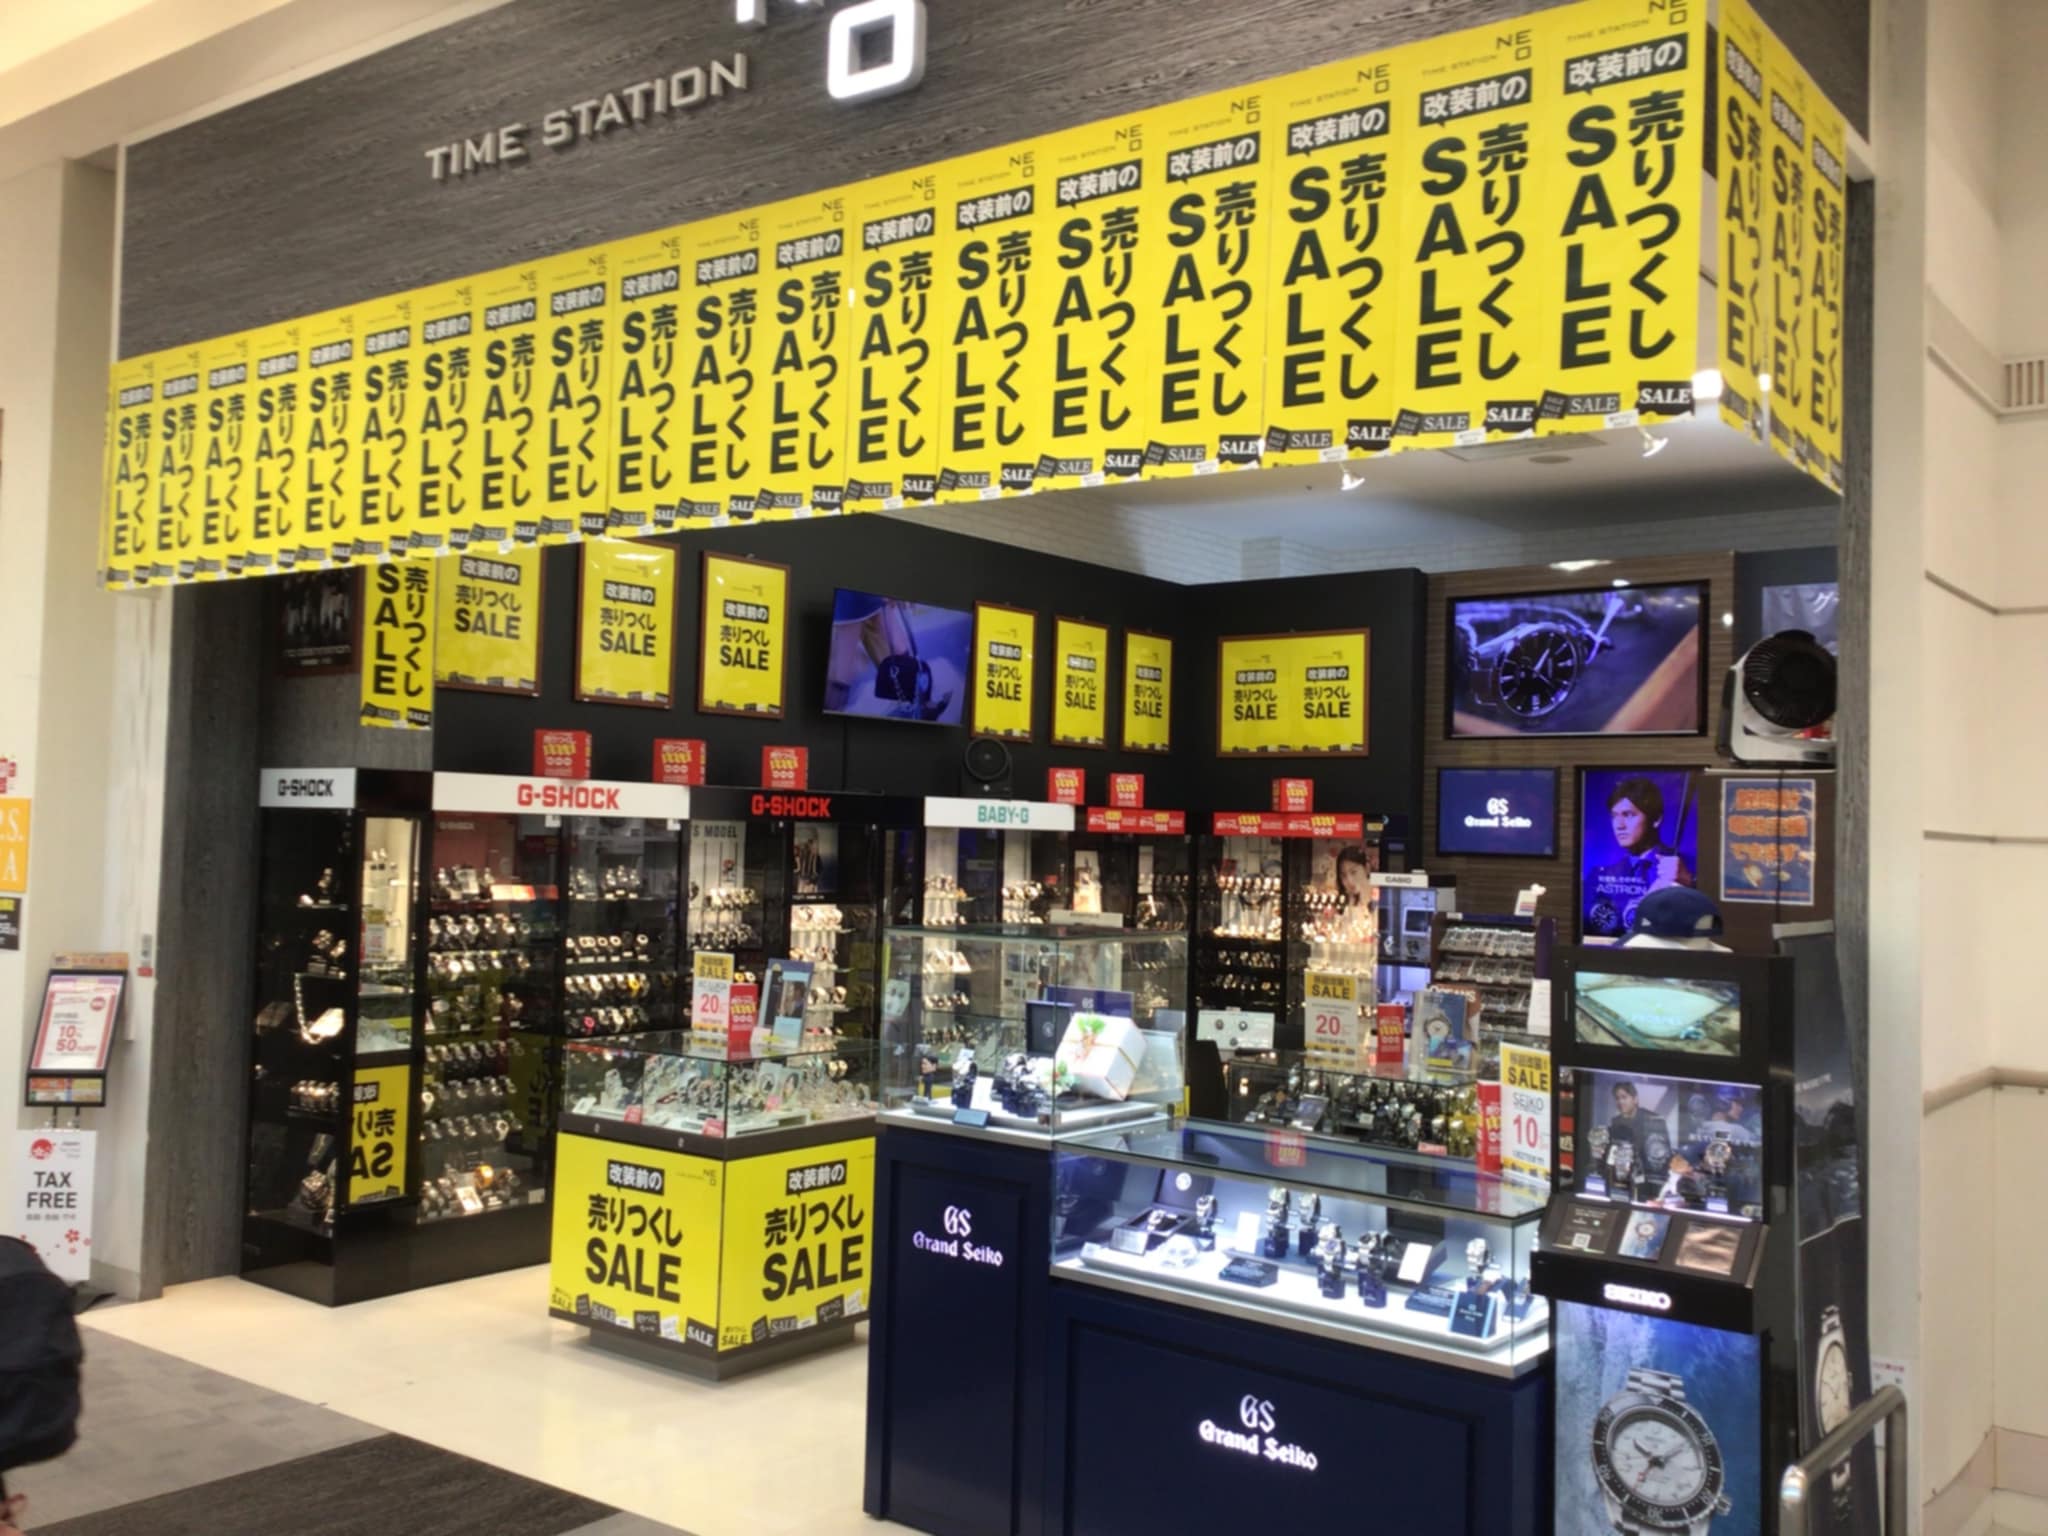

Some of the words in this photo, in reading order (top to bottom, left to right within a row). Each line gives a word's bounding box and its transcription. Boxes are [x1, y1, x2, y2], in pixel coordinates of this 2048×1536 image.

[1568, 39, 1684, 88] 改装前の
[425, 123, 526, 179] TIME
[542, 52, 747, 146] STATION
[1423, 74, 1528, 120] 改装前の
[1291, 107, 1387, 150] 改装前の
[1170, 137, 1257, 177] 改装前の
[1060, 164, 1139, 202] 改装前の
[959, 189, 1031, 225] 改装前の
[1626, 89, 1684, 359] 売りつくし
[865, 212, 932, 246] 改装前の
[1560, 105, 1618, 369] SALE
[779, 233, 841, 264] 改装前の
[1415, 138, 1468, 389] SALE
[1475, 122, 1529, 380] 売りつくし
[1283, 166, 1330, 408] SALE
[1337, 153, 1387, 399] 売りつくし
[1161, 194, 1205, 424] SALE
[1211, 181, 1256, 416] 売りつくし
[995, 231, 1031, 445] 売りつくし
[1052, 218, 1093, 438] SALE
[1099, 207, 1139, 431] 売りつくし
[858, 260, 893, 463] SALE
[897, 252, 933, 458] 売りつくし
[953, 240, 990, 452] SALE
[690, 296, 722, 483] SALE
[726, 289, 757, 479] 売りつくし
[770, 279, 804, 473] SALE
[808, 272, 841, 469] 売りつくし
[548, 326, 573, 501] SALE
[577, 319, 604, 498] 売りつくし
[619, 311, 646, 493] SALE
[650, 304, 677, 489] 売りつくし
[1486, 407, 1534, 422] SALE
[1570, 396, 1619, 412] SALE
[1639, 388, 1691, 404] SALE
[419, 353, 443, 518] SALE
[481, 340, 507, 511] SALE
[511, 334, 535, 507] 売りつくし
[1290, 432, 1332, 447] SALE
[1347, 425, 1391, 441] SALE
[1423, 415, 1468, 430] SALE
[254, 388, 274, 538] SALE
[306, 378, 327, 532] SALE
[361, 366, 384, 525] SALE
[1105, 454, 1141, 468] SALE
[1167, 447, 1204, 462] SALE
[1220, 441, 1258, 455] SALE
[903, 479, 934, 493] SALE
[1002, 468, 1033, 481] SALE
[1057, 460, 1091, 474] SALE
[813, 490, 841, 502] SALE
[373, 564, 400, 695] SALE
[404, 567, 429, 697] 売りつくし
[454, 608, 521, 640] SALE
[599, 629, 656, 657] SALE
[720, 645, 769, 671] SALE
[986, 680, 1022, 701] SALE
[1065, 691, 1096, 710] SALE
[1134, 700, 1162, 718] SALE
[1233, 704, 1277, 721] SALE
[1304, 702, 1350, 719] SALE
[278, 779, 334, 796] G-SHOCK
[517, 783, 620, 809] G-SHOCK
[751, 794, 831, 817] G-SHOCK
[977, 805, 1030, 824] BABY-G
[700, 993, 719, 1013] 20
[1312, 984, 1350, 999] SALE
[1315, 1014, 1341, 1036] 20
[1507, 1066, 1549, 1091] SALE
[1513, 1114, 1538, 1148] 10
[33, 1171, 72, 1188] TAX
[609, 1163, 663, 1190] 改装前の
[788, 1163, 845, 1191] 改装前の
[26, 1192, 78, 1209] FREE
[587, 1193, 683, 1247] 売りつくし
[764, 1193, 864, 1248] 売りつくし
[944, 1205, 972, 1237] GS
[912, 1230, 958, 1257] Grand
[962, 1241, 1003, 1266] Seiko
[585, 1237, 682, 1304] SALE
[762, 1234, 864, 1302] SALE
[687, 1324, 714, 1347] SALE
[1240, 1394, 1275, 1433] GS
[1198, 1418, 1259, 1456] Grand
[1262, 1437, 1318, 1471] Seiko
